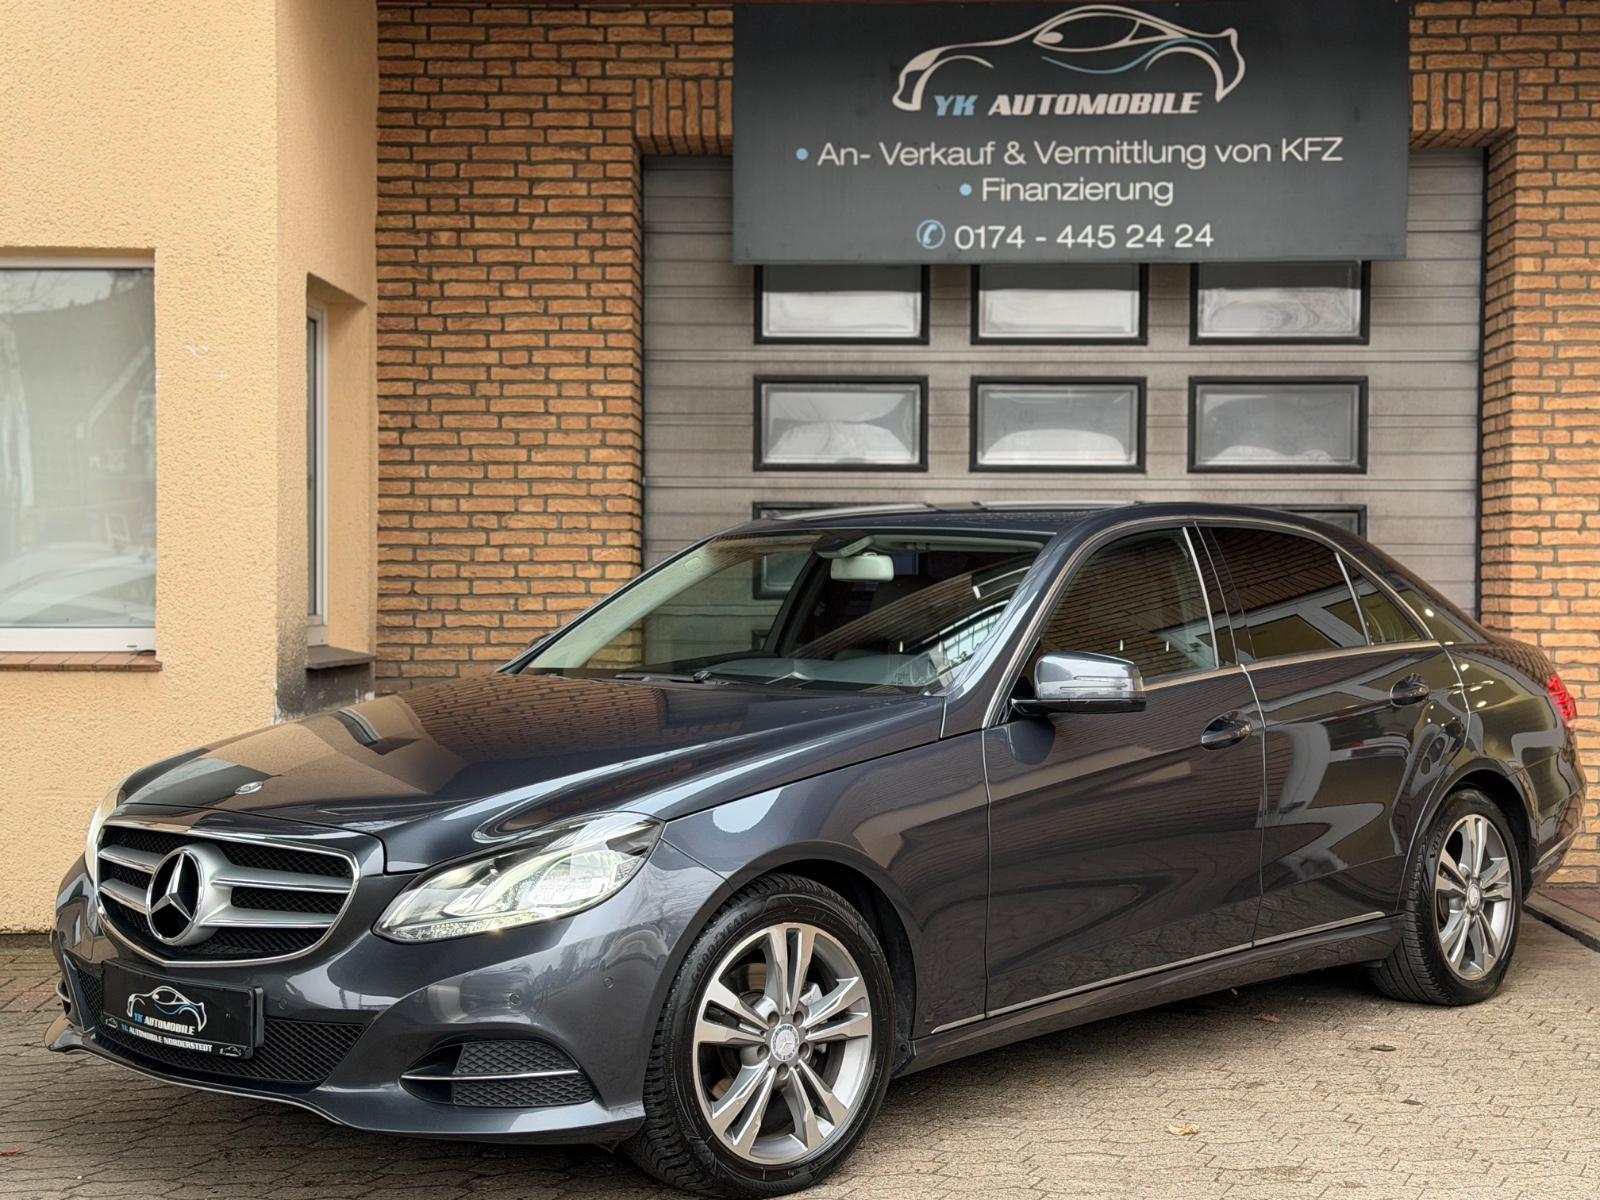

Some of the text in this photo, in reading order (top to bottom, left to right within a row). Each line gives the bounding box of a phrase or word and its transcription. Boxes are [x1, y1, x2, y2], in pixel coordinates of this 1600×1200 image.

[934, 92, 1202, 116] YK AUTOMOBILE
[817, 136, 1343, 170] An- Verkauf & Vermittlung von KFZ
[982, 177, 1174, 207] Finanzierung
[954, 225, 1025, 250] 0174
[1056, 224, 1116, 249] 445
[1125, 224, 1165, 248] 24
[1174, 223, 1214, 248] 24
[144, 1016, 195, 1035] AUTOMOBILE
